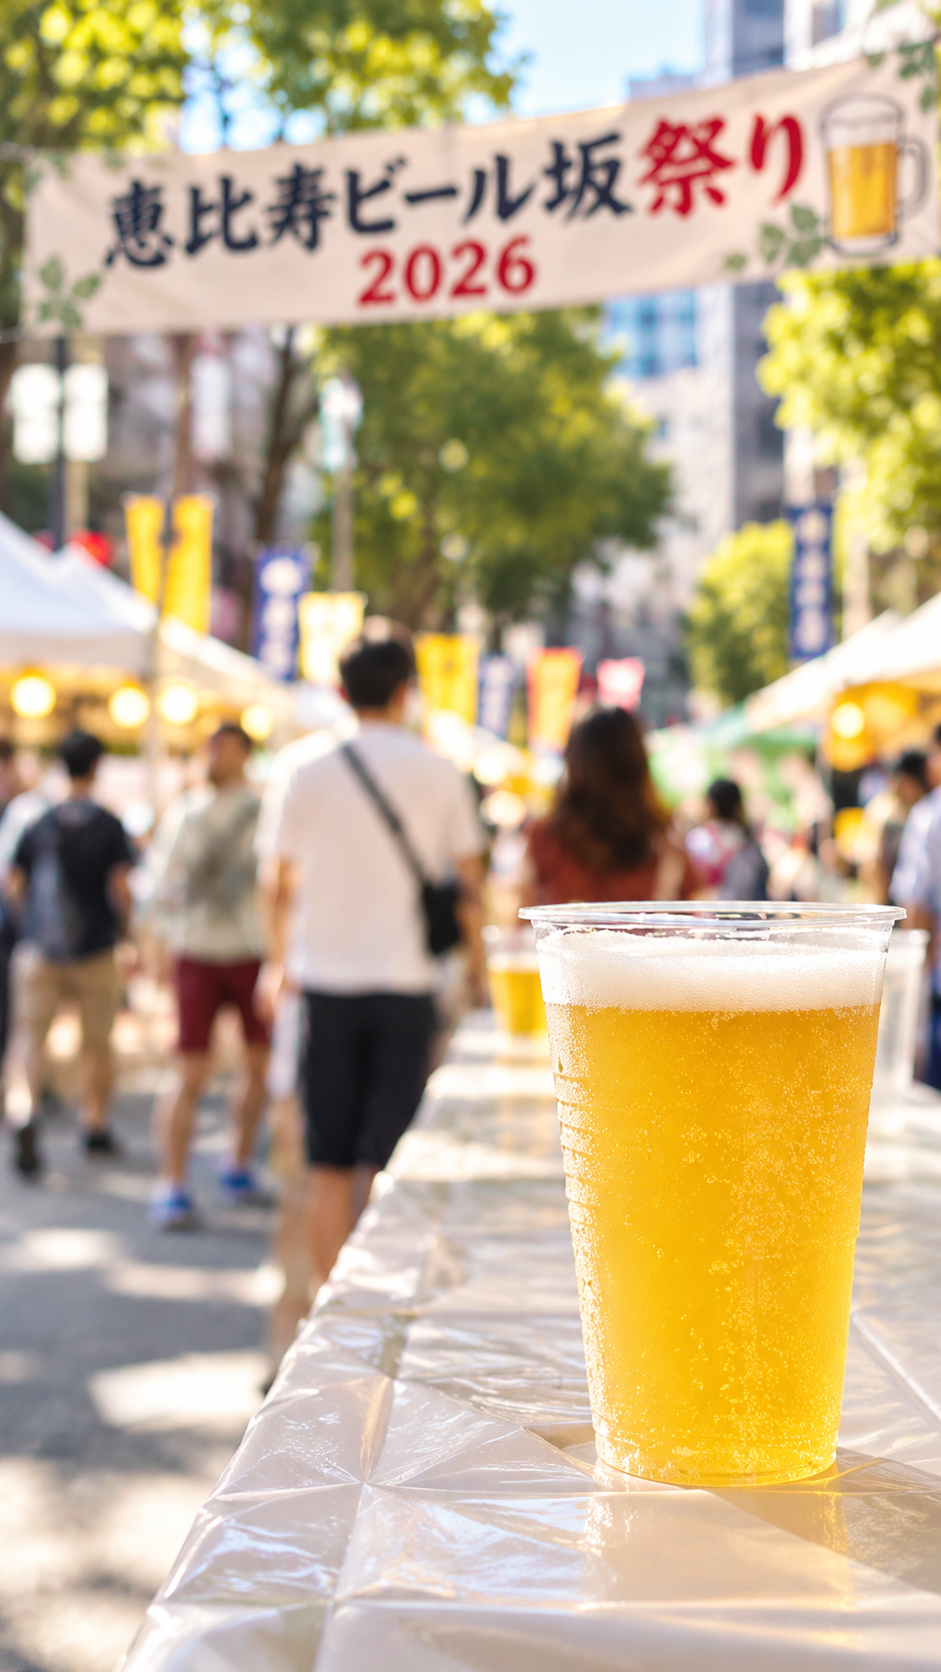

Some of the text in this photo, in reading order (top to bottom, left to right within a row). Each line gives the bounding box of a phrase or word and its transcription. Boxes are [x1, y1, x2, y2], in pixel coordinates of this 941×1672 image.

[104, 113, 806, 268] 恵比寿ビール坂祭り
[358, 235, 536, 307] 2026
